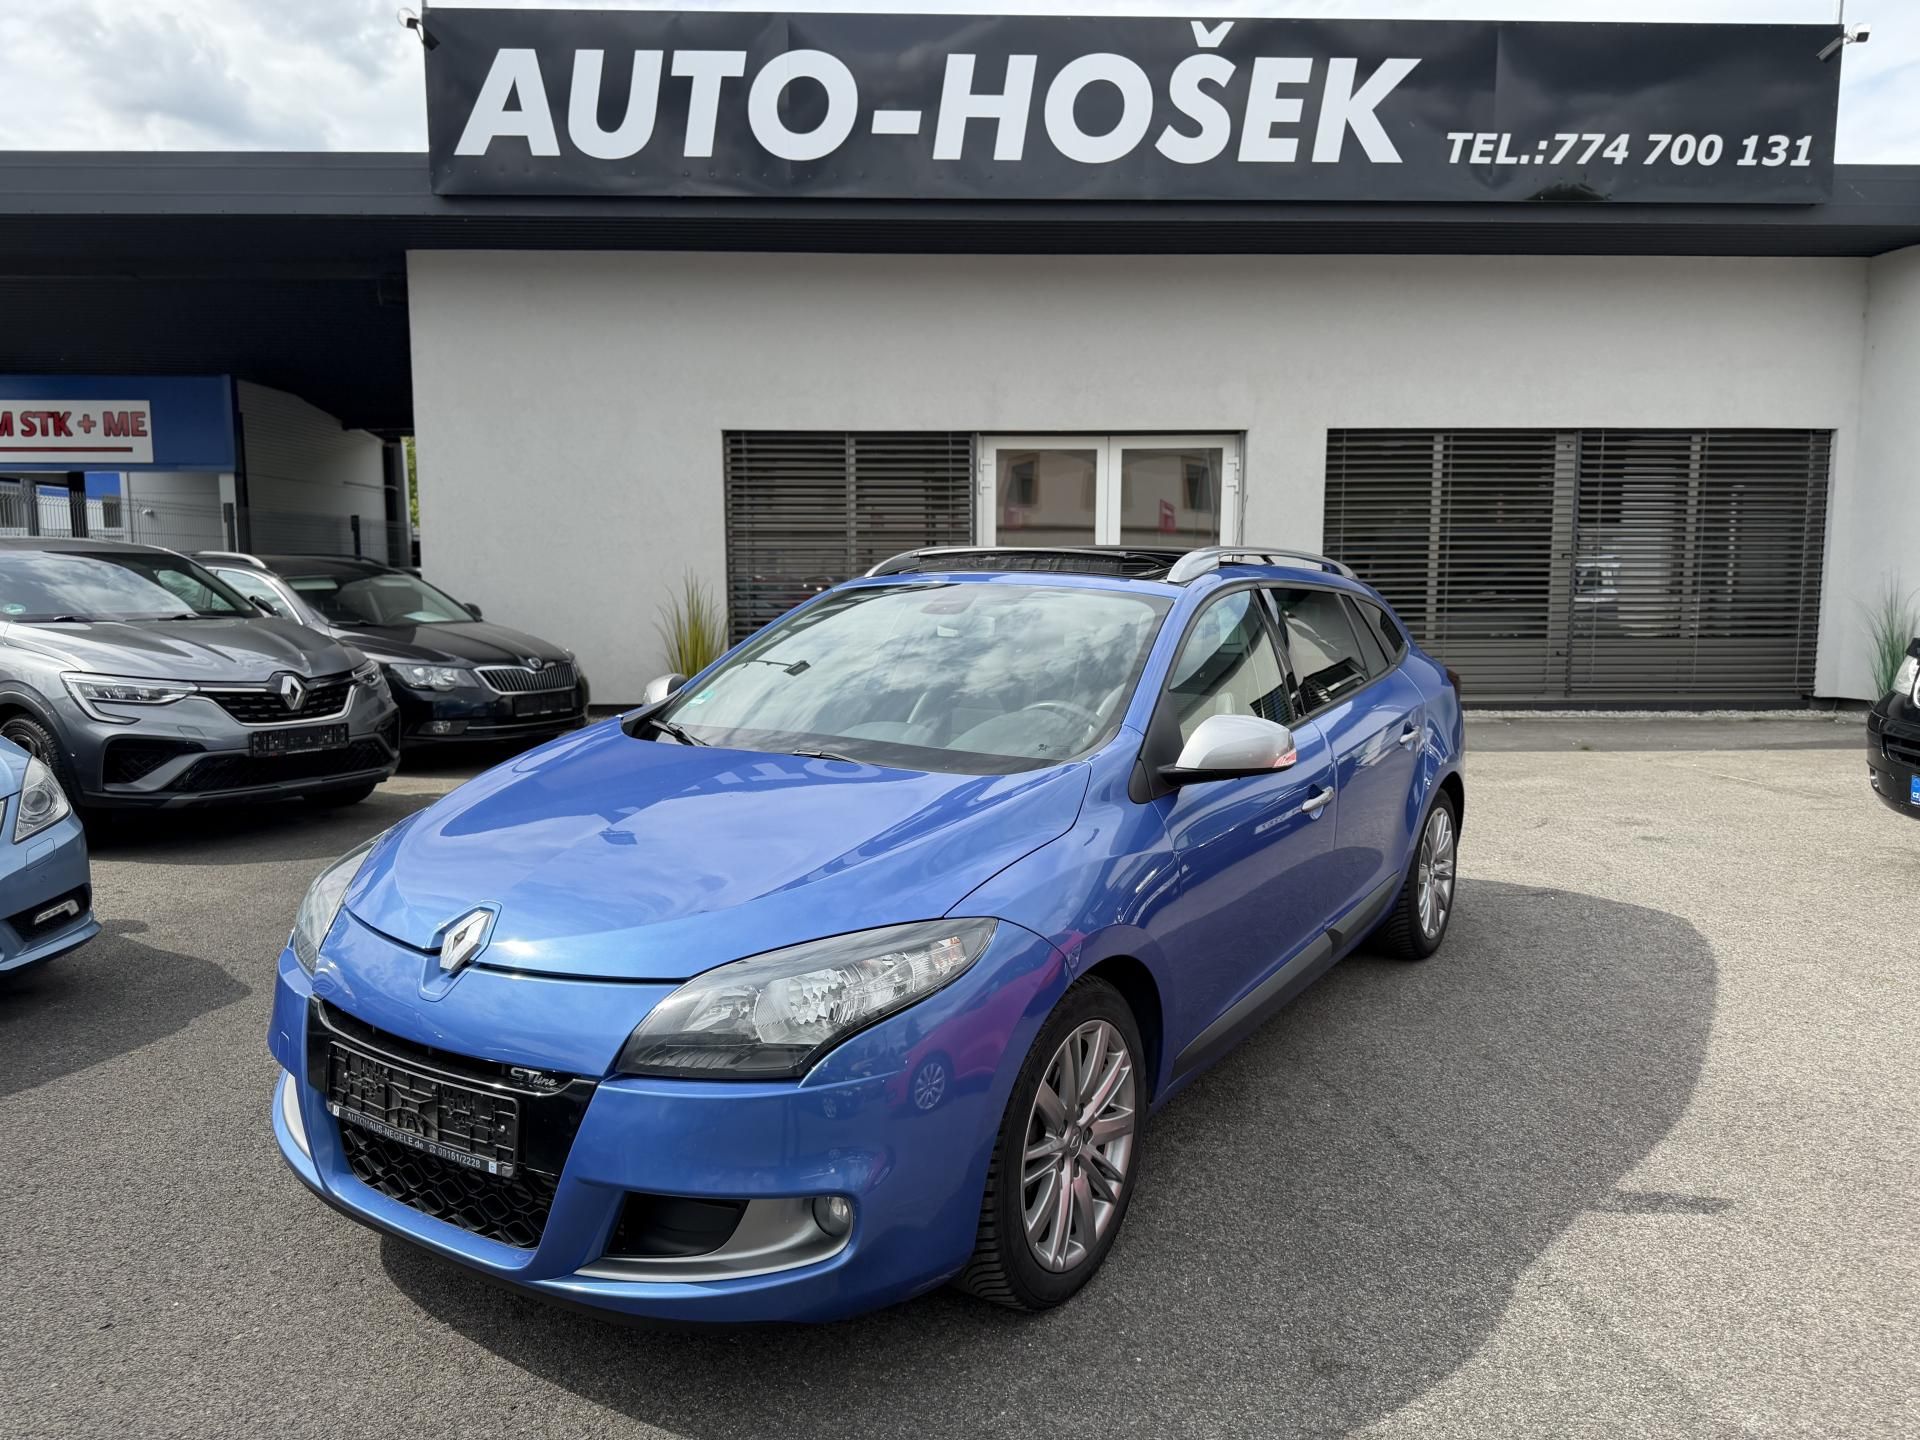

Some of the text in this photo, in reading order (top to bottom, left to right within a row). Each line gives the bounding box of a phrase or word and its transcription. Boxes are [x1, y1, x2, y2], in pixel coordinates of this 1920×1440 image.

[455, 21, 1421, 164] AUTO-HOŠEK
[1644, 133, 1724, 167] 700
[1737, 134, 1812, 168] 131
[20, 411, 73, 437] STK
[102, 411, 148, 437] ME
